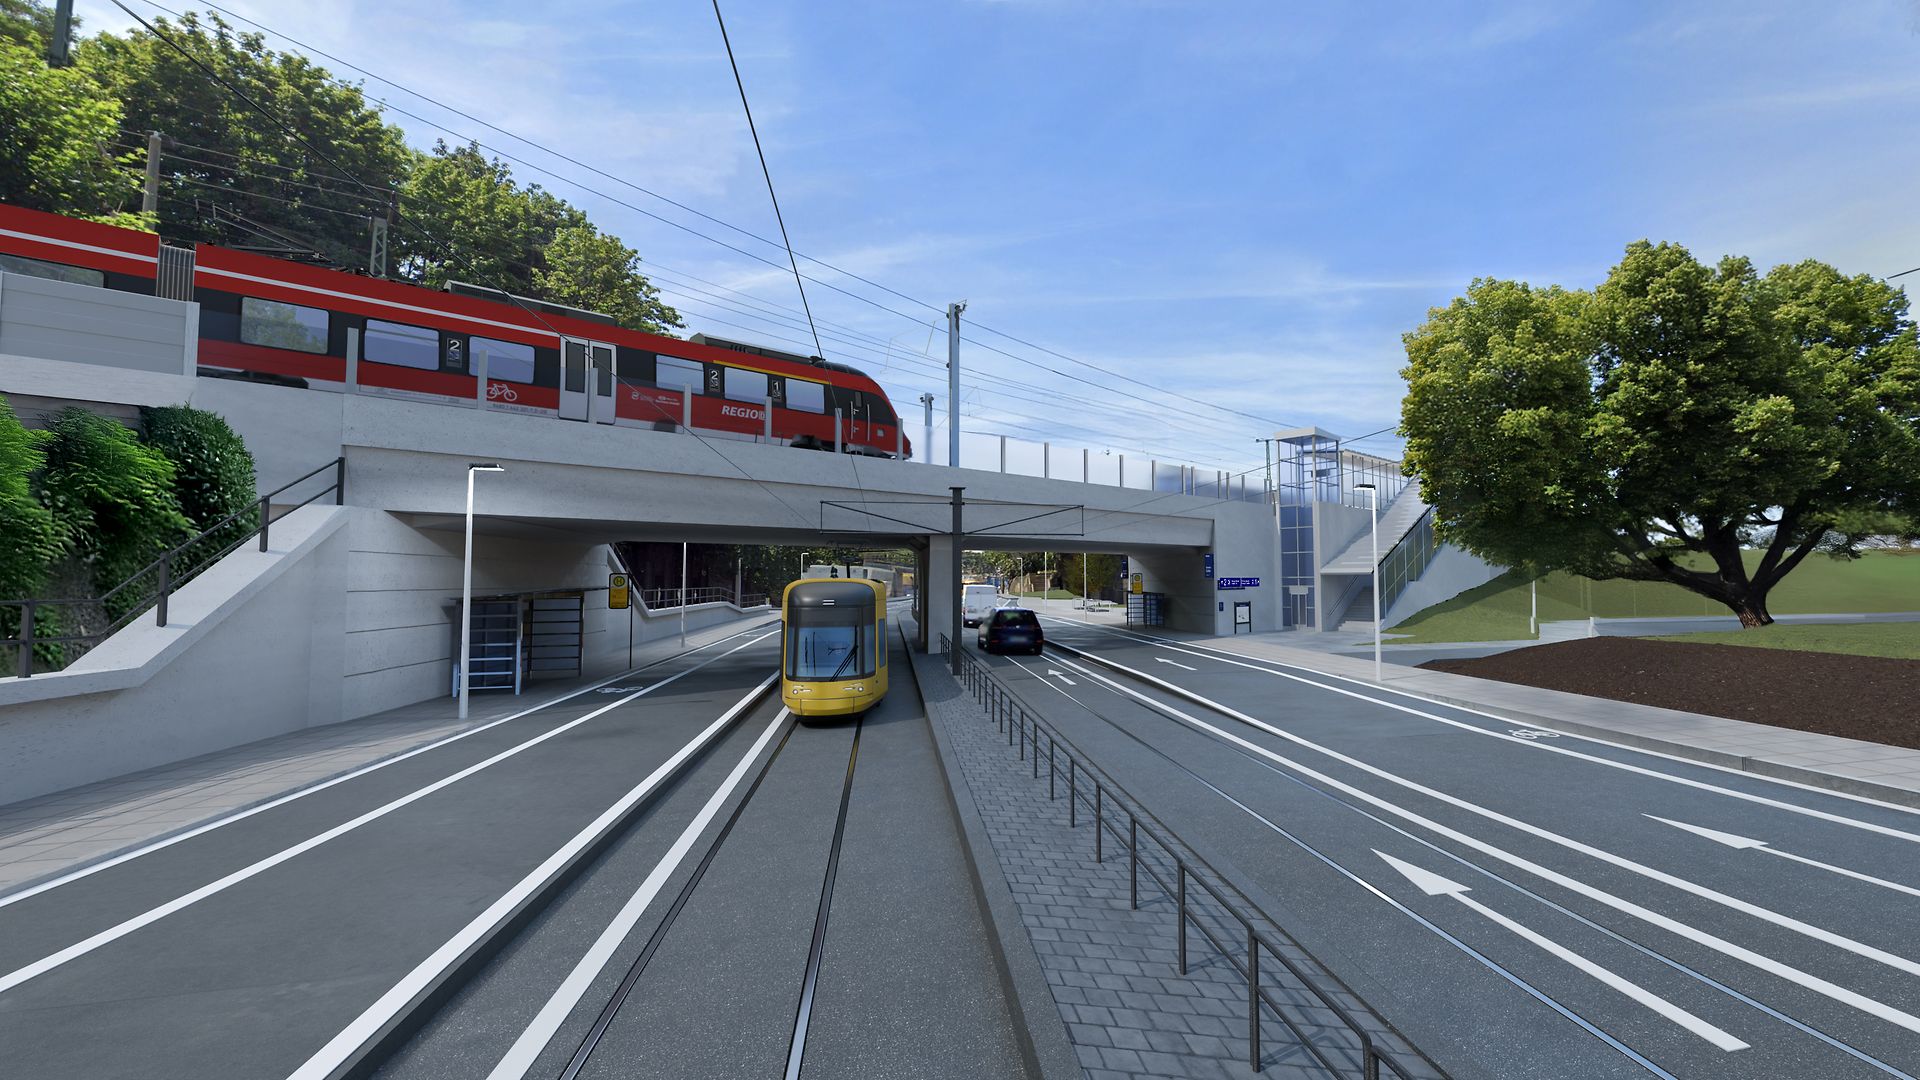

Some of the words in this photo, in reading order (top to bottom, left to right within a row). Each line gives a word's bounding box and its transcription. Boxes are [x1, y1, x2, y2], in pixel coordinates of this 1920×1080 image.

[450, 339, 460, 352] 2
[711, 370, 718, 380] 2
[774, 381, 779, 390] 1
